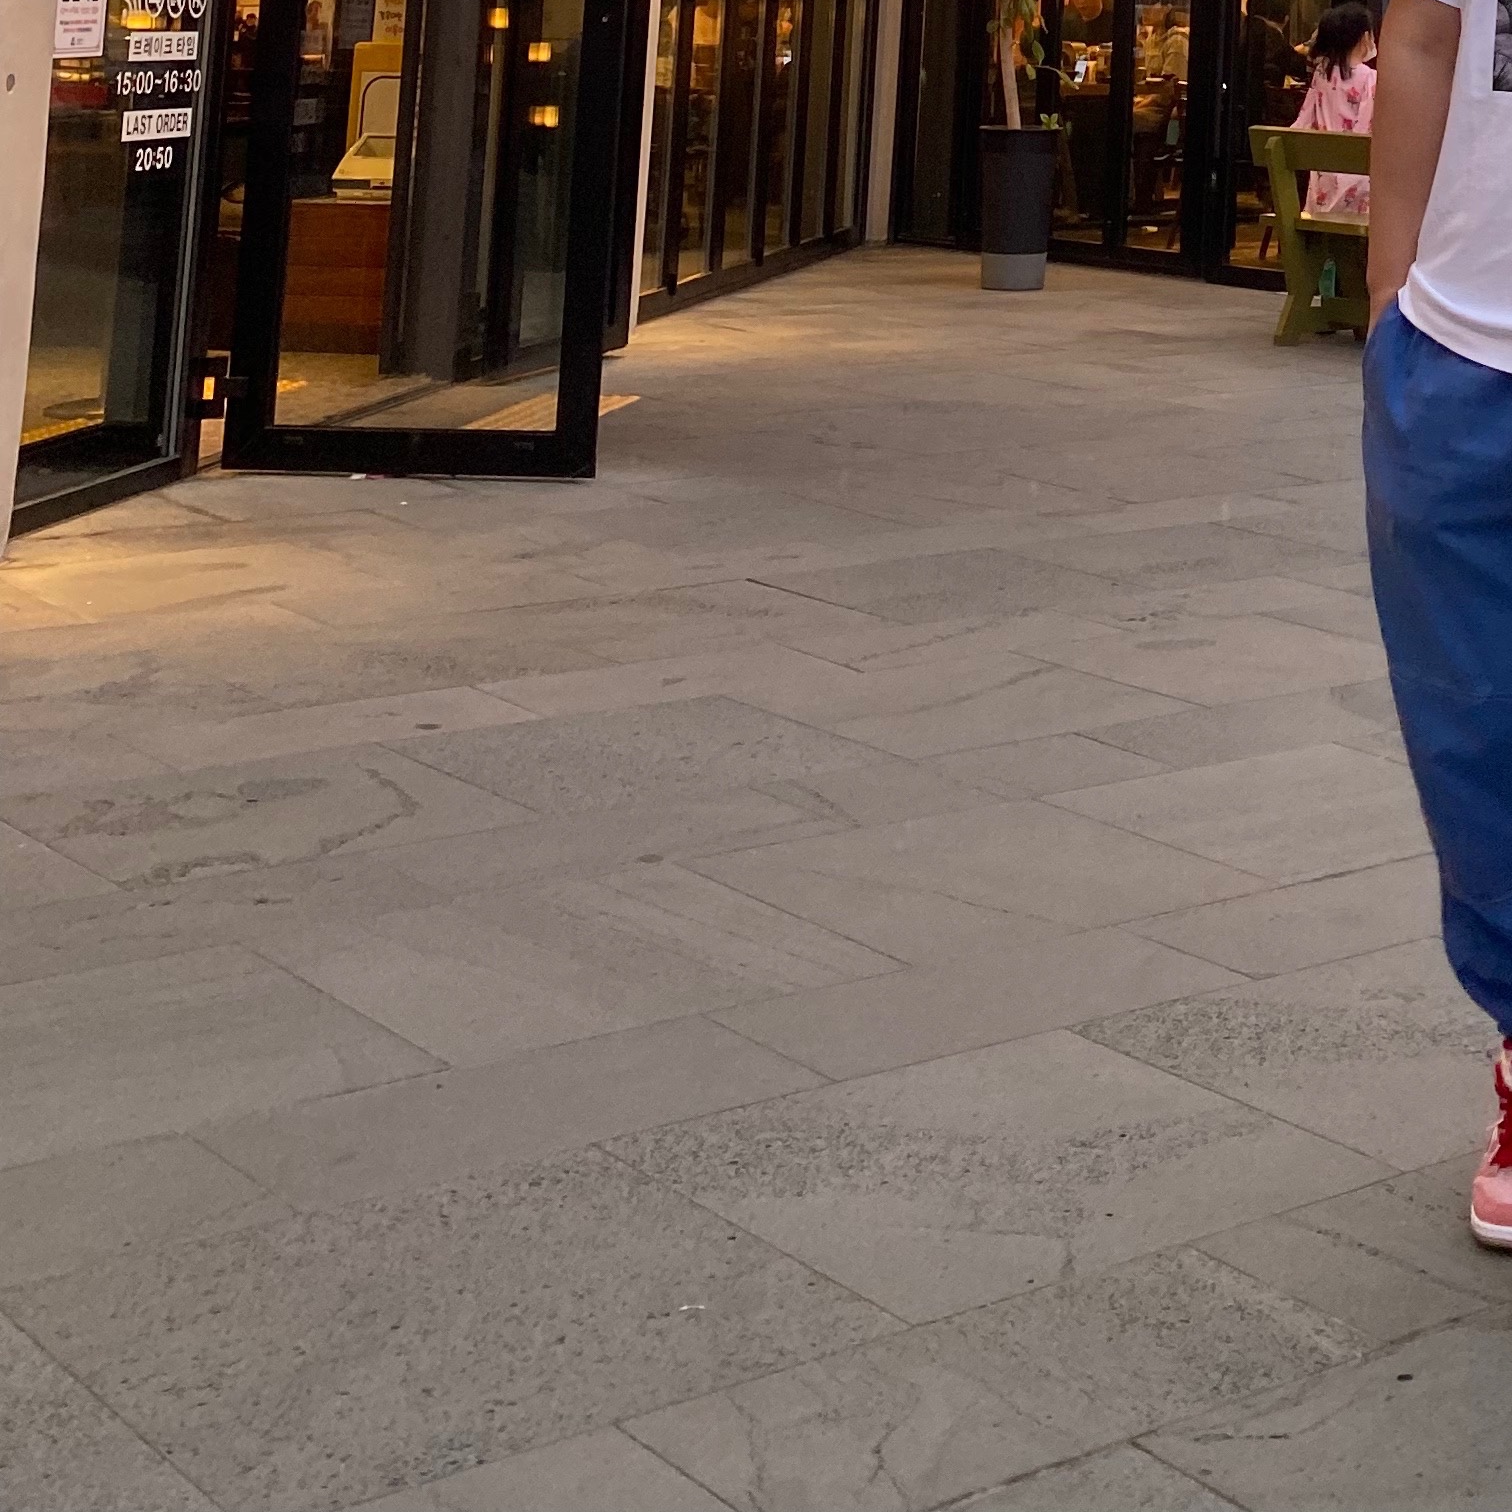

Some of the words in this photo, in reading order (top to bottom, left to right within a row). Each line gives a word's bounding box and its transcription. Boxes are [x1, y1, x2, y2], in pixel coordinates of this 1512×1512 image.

[126, 114, 153, 136] LAST
[156, 112, 188, 134] ORDER
[135, 146, 173, 172] 20:50
